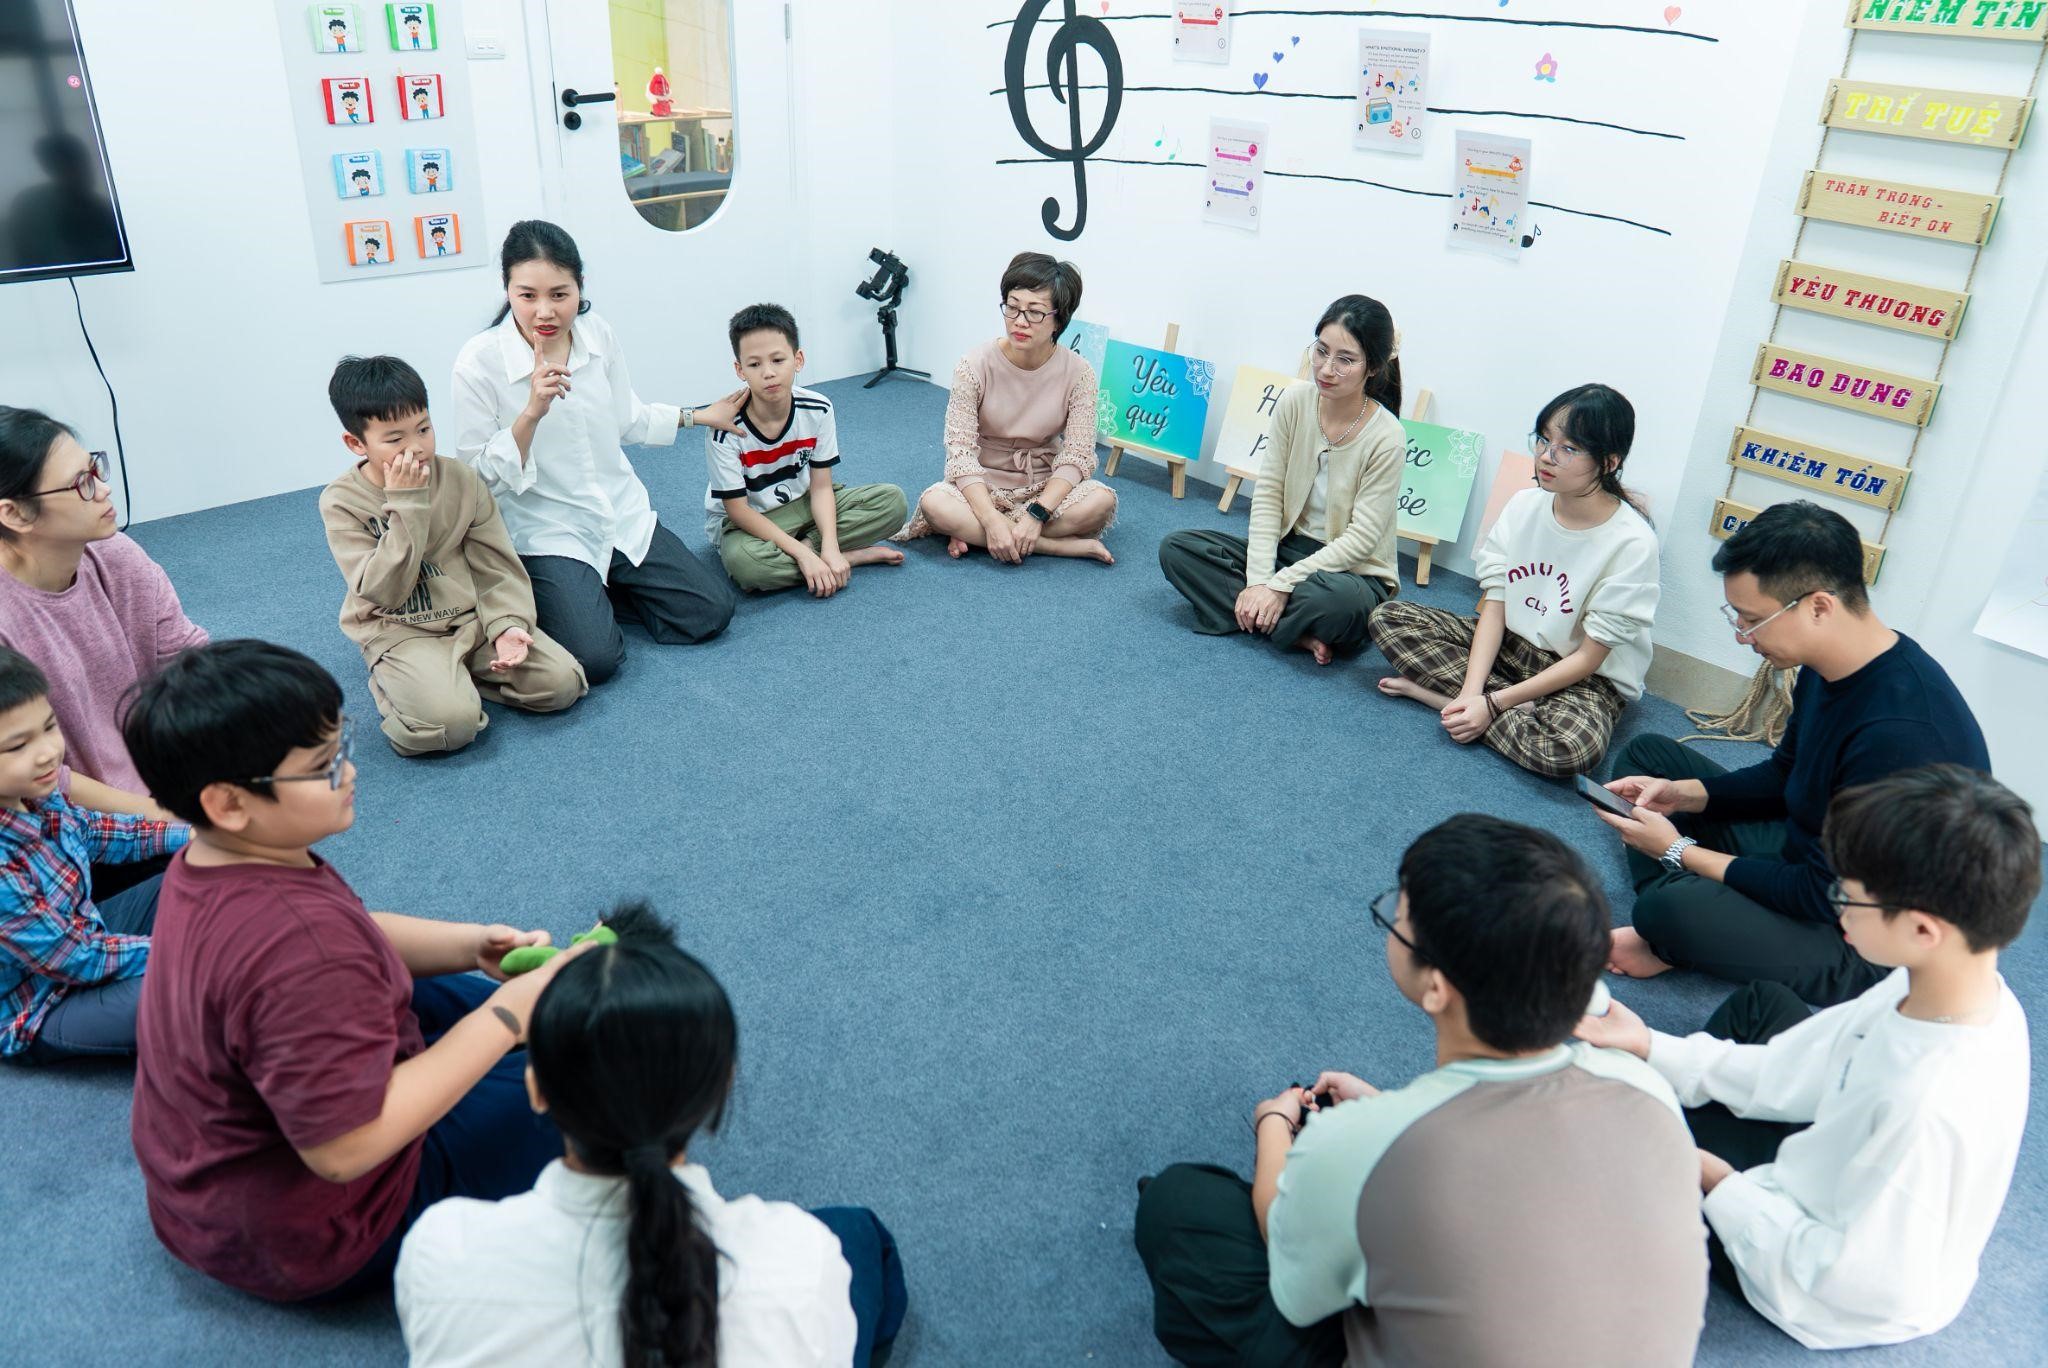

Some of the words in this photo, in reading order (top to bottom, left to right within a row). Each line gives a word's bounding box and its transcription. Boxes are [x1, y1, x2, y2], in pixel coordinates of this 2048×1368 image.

[1789, 275, 1839, 301] YÊU
[1132, 355, 1178, 397] Yêu
[1769, 358, 1825, 388] BAO
[1829, 373, 1914, 409] DUNG
[1126, 404, 1169, 437] quý
[409, 613, 433, 623] NEW
